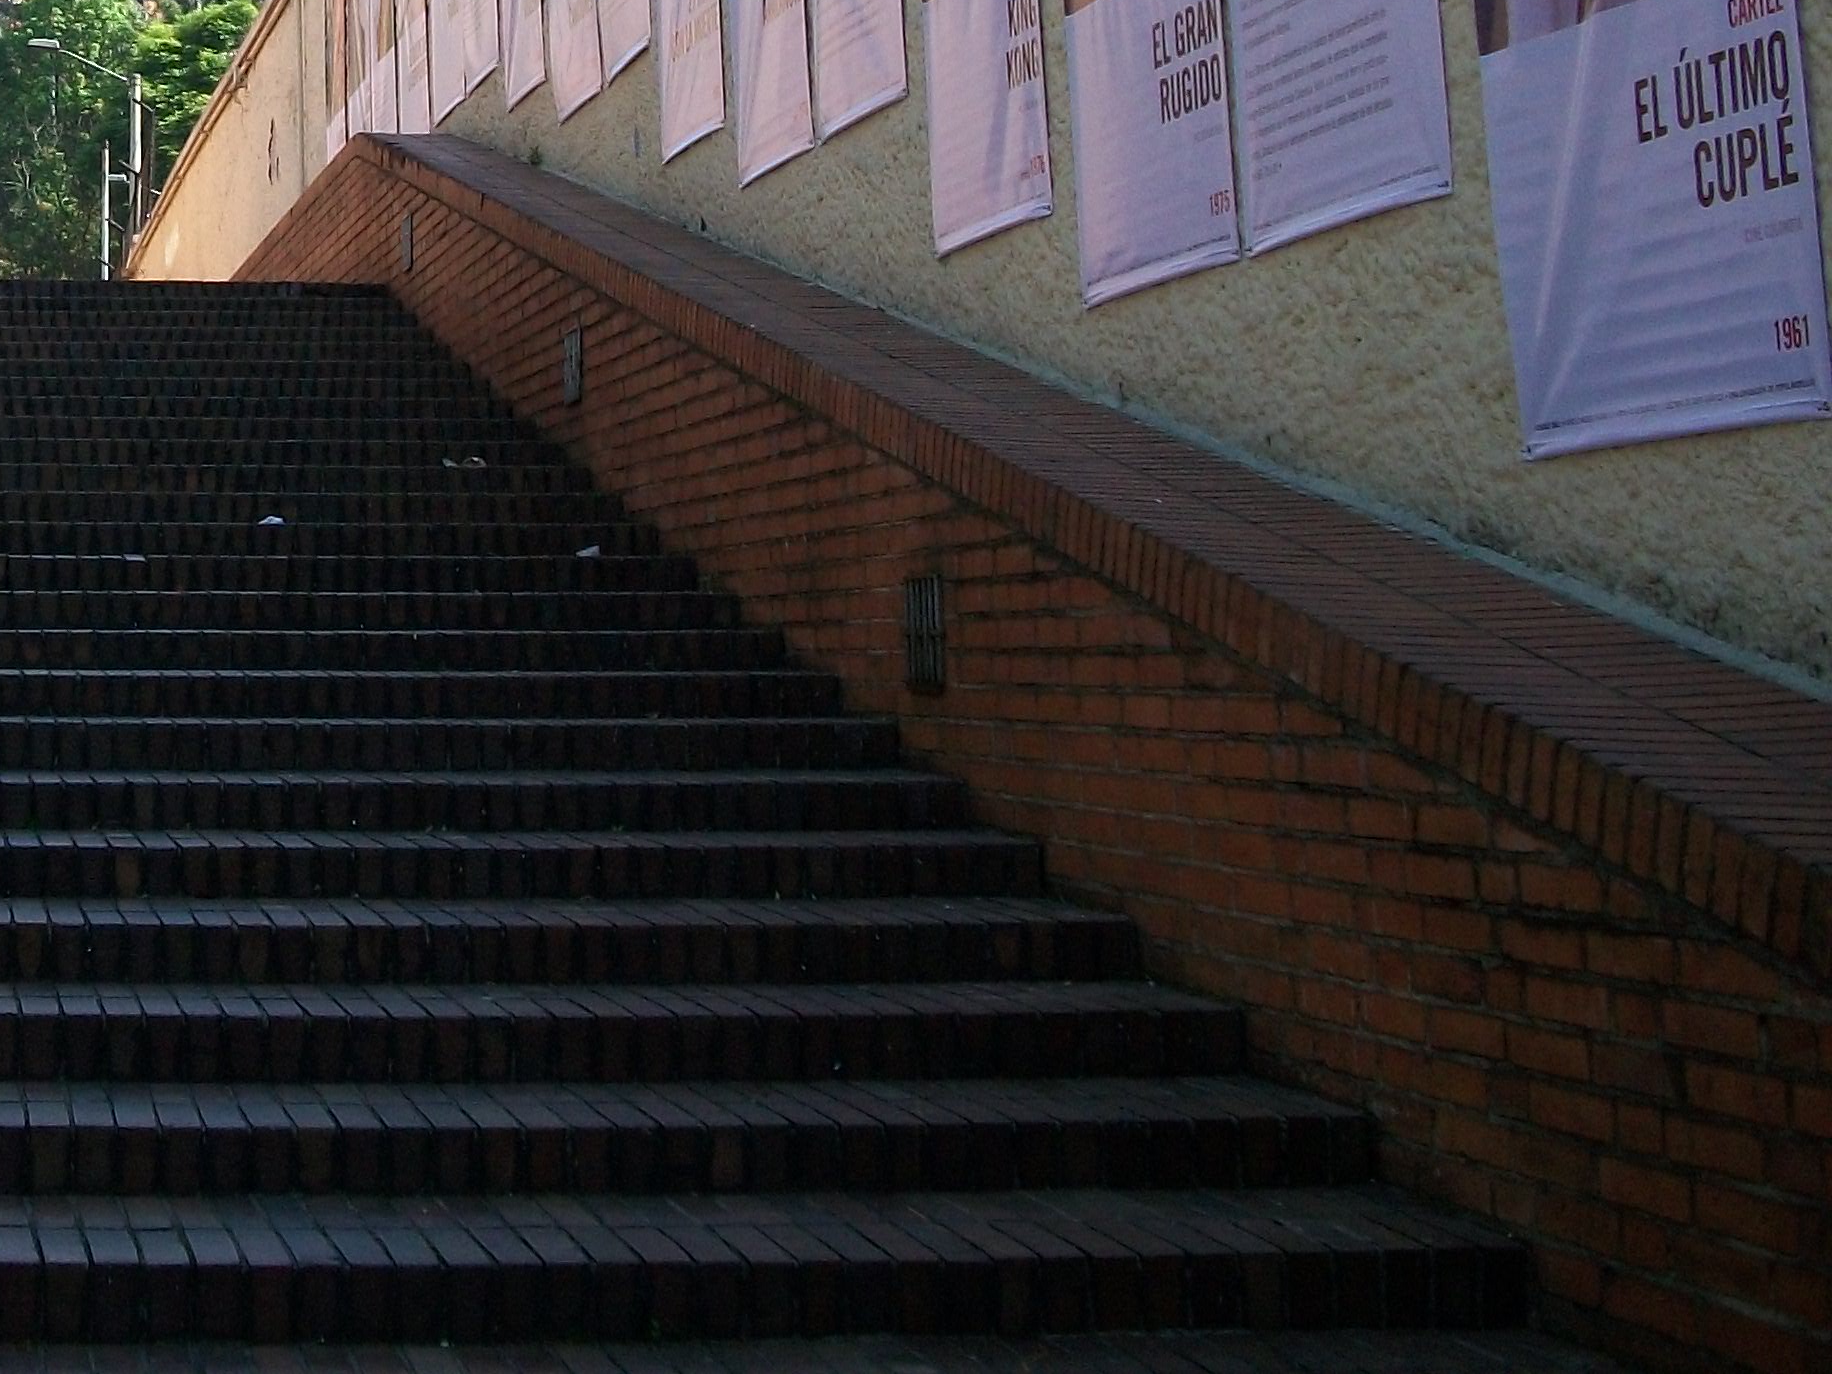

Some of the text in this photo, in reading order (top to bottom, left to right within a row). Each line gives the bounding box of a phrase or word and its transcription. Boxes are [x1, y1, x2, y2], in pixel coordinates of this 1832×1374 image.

[1005, 38, 1040, 89] KONG
[1152, 20, 1172, 70] EL
[1160, 53, 1222, 124] RUGIDO
[1634, 29, 1790, 145] EL ÚLTIMO
[1693, 97, 1799, 208] CUPLÉ
[1774, 314, 1811, 353] 1961
